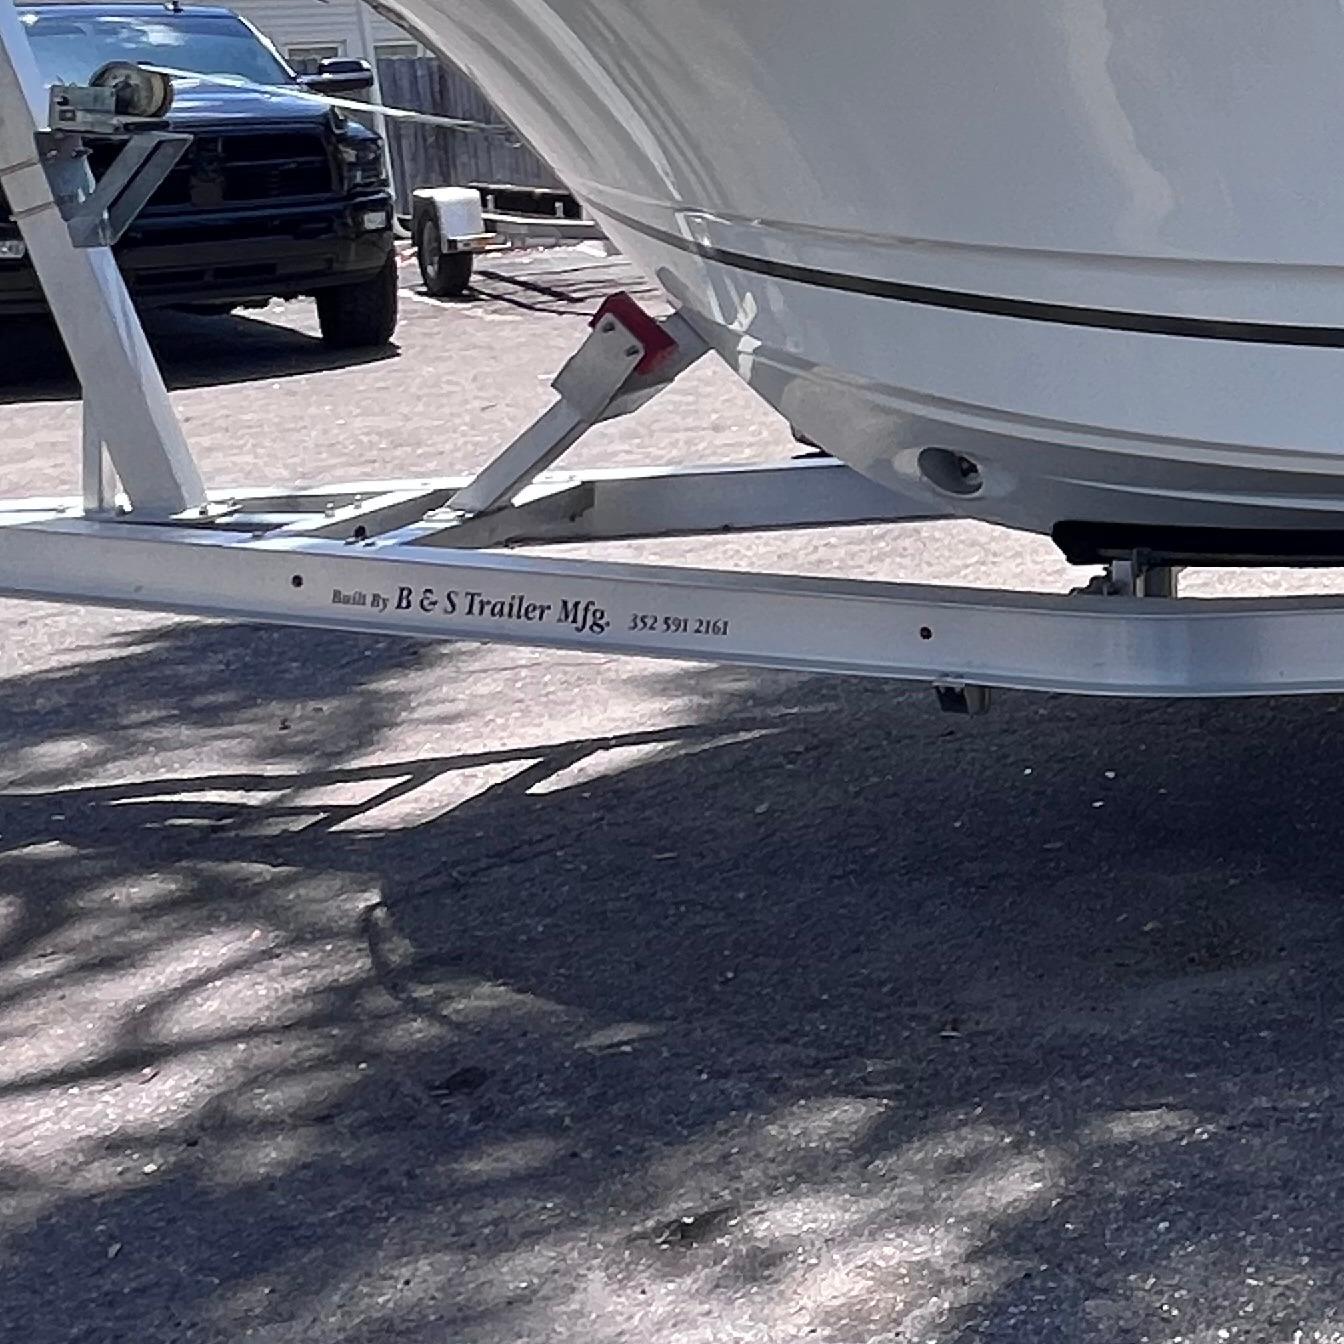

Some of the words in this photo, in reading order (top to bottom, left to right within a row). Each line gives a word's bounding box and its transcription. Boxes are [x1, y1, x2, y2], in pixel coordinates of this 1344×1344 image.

[331, 588, 367, 606] Built
[370, 592, 390, 613] By
[395, 586, 413, 611] B
[419, 587, 438, 612] &
[443, 590, 459, 615] S
[464, 591, 551, 623] Trailer
[557, 598, 611, 635] Mfg.
[628, 613, 658, 632] 352
[662, 616, 688, 633] 591
[693, 618, 730, 636] 2161
